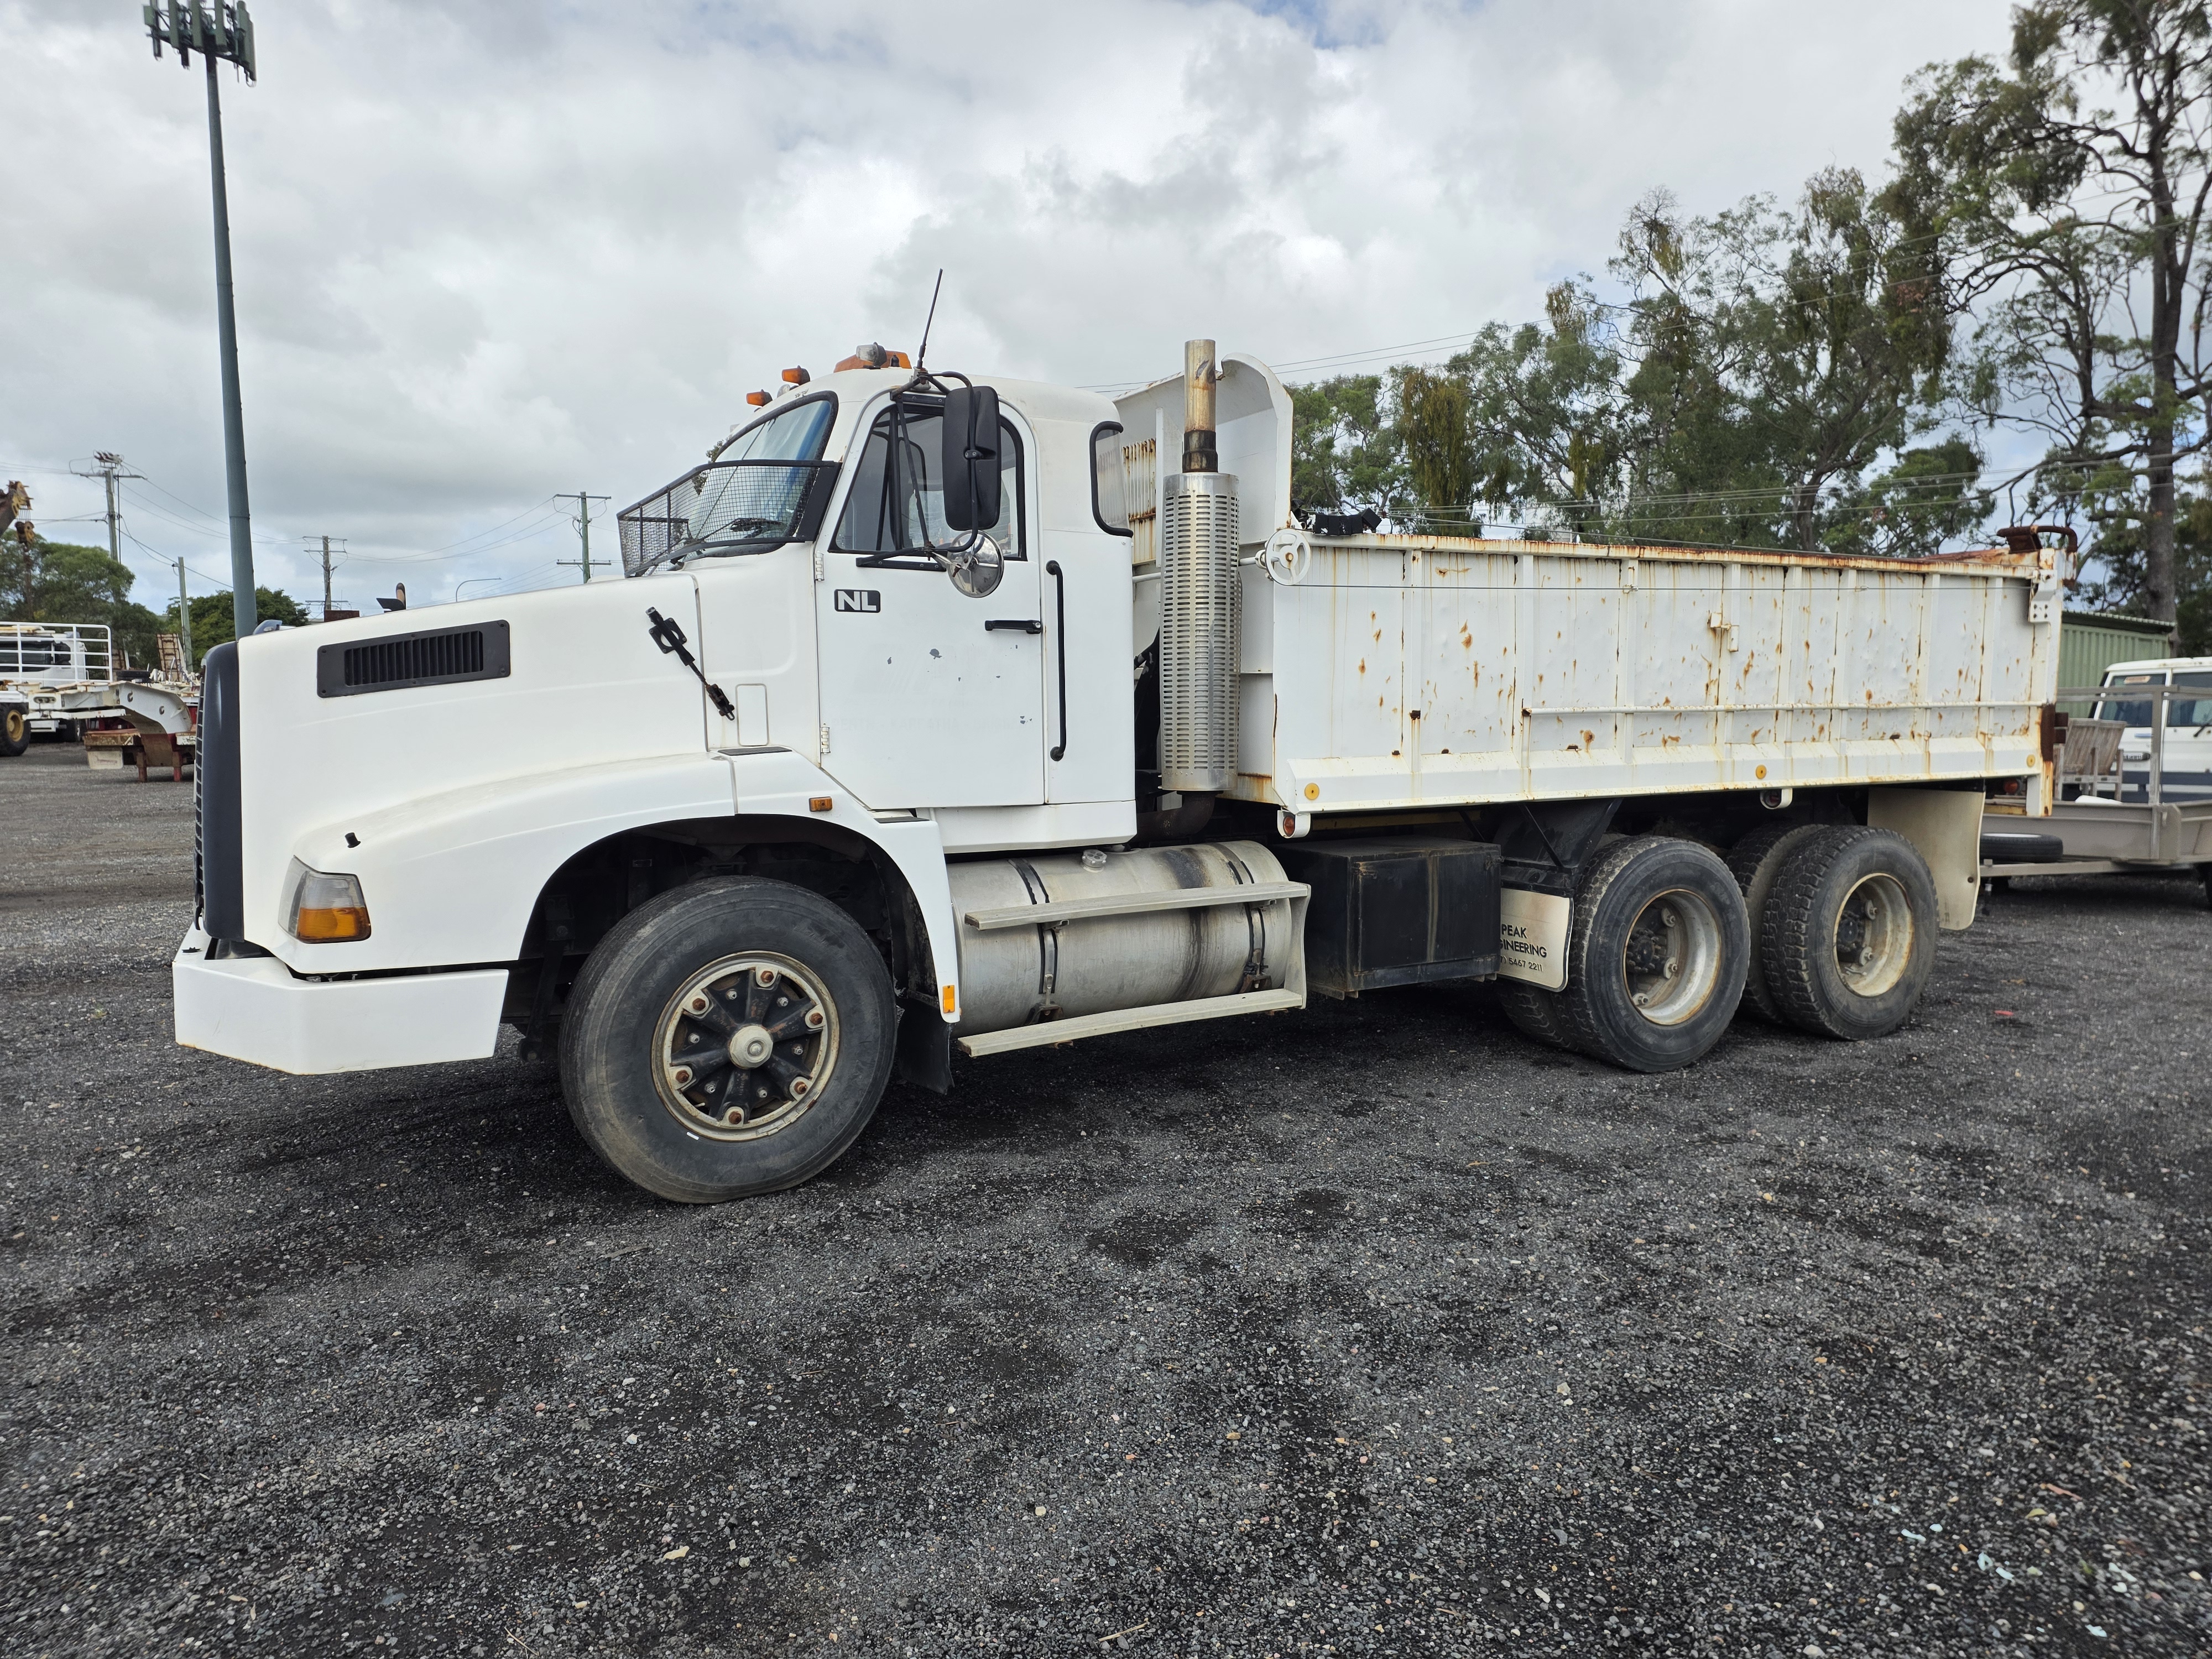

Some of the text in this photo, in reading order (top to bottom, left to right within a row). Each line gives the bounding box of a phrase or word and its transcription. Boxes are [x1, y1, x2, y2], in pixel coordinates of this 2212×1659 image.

[837, 591, 877, 611] NL
[1501, 924, 1527, 938] PEAK
[1509, 957, 1526, 967] 5467
[1528, 962, 1542, 971] 2211
